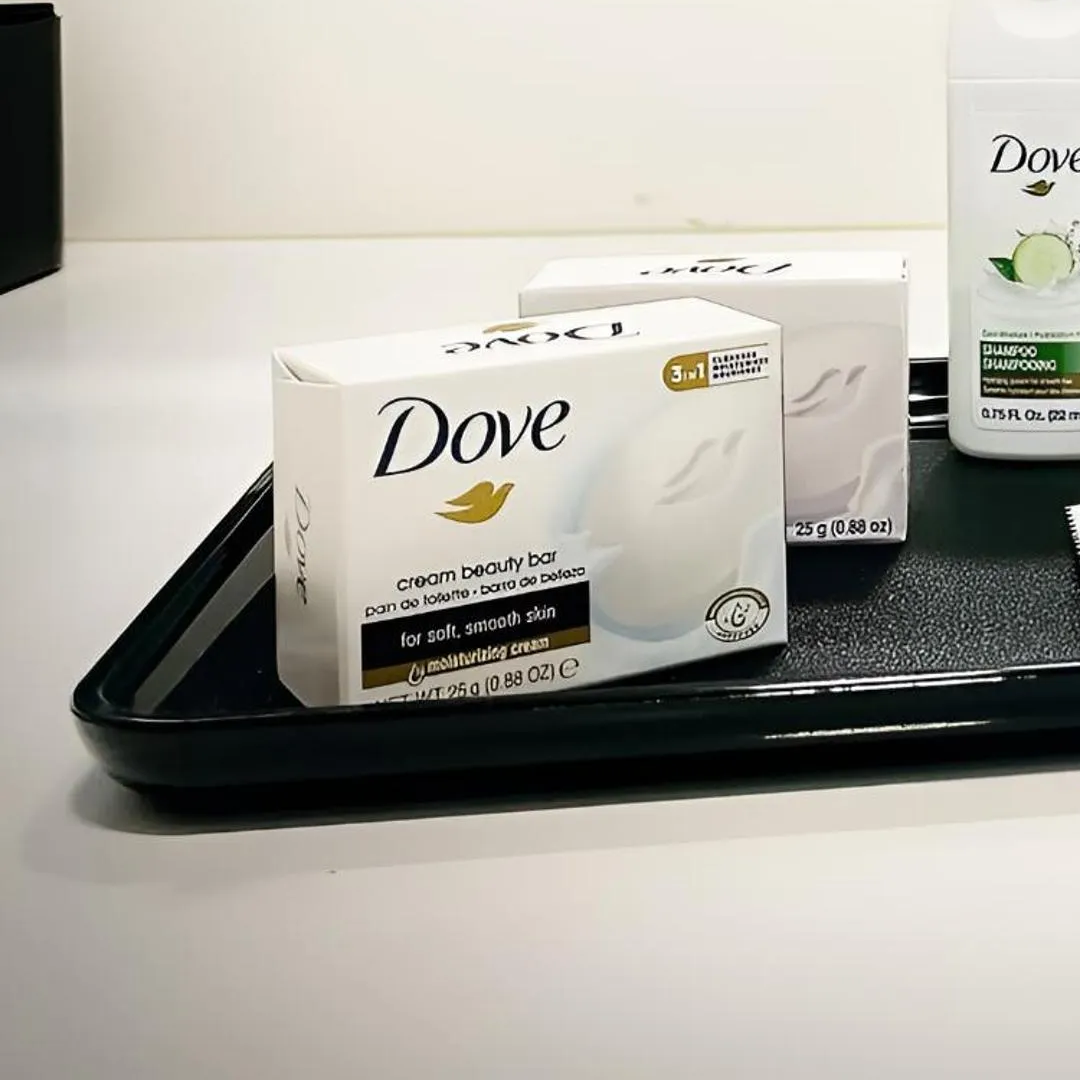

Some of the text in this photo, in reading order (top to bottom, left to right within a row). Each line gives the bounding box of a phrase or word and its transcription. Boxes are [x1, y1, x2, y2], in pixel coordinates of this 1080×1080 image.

[373, 396, 570, 478] Dove
[795, 521, 814, 536] 25
[817, 523, 827, 538] g
[397, 550, 557, 591] cream beauty bar
[400, 631, 421, 648] for
[465, 610, 521, 636] smooth
[526, 605, 557, 624] skin
[485, 671, 523, 695] (0.88
